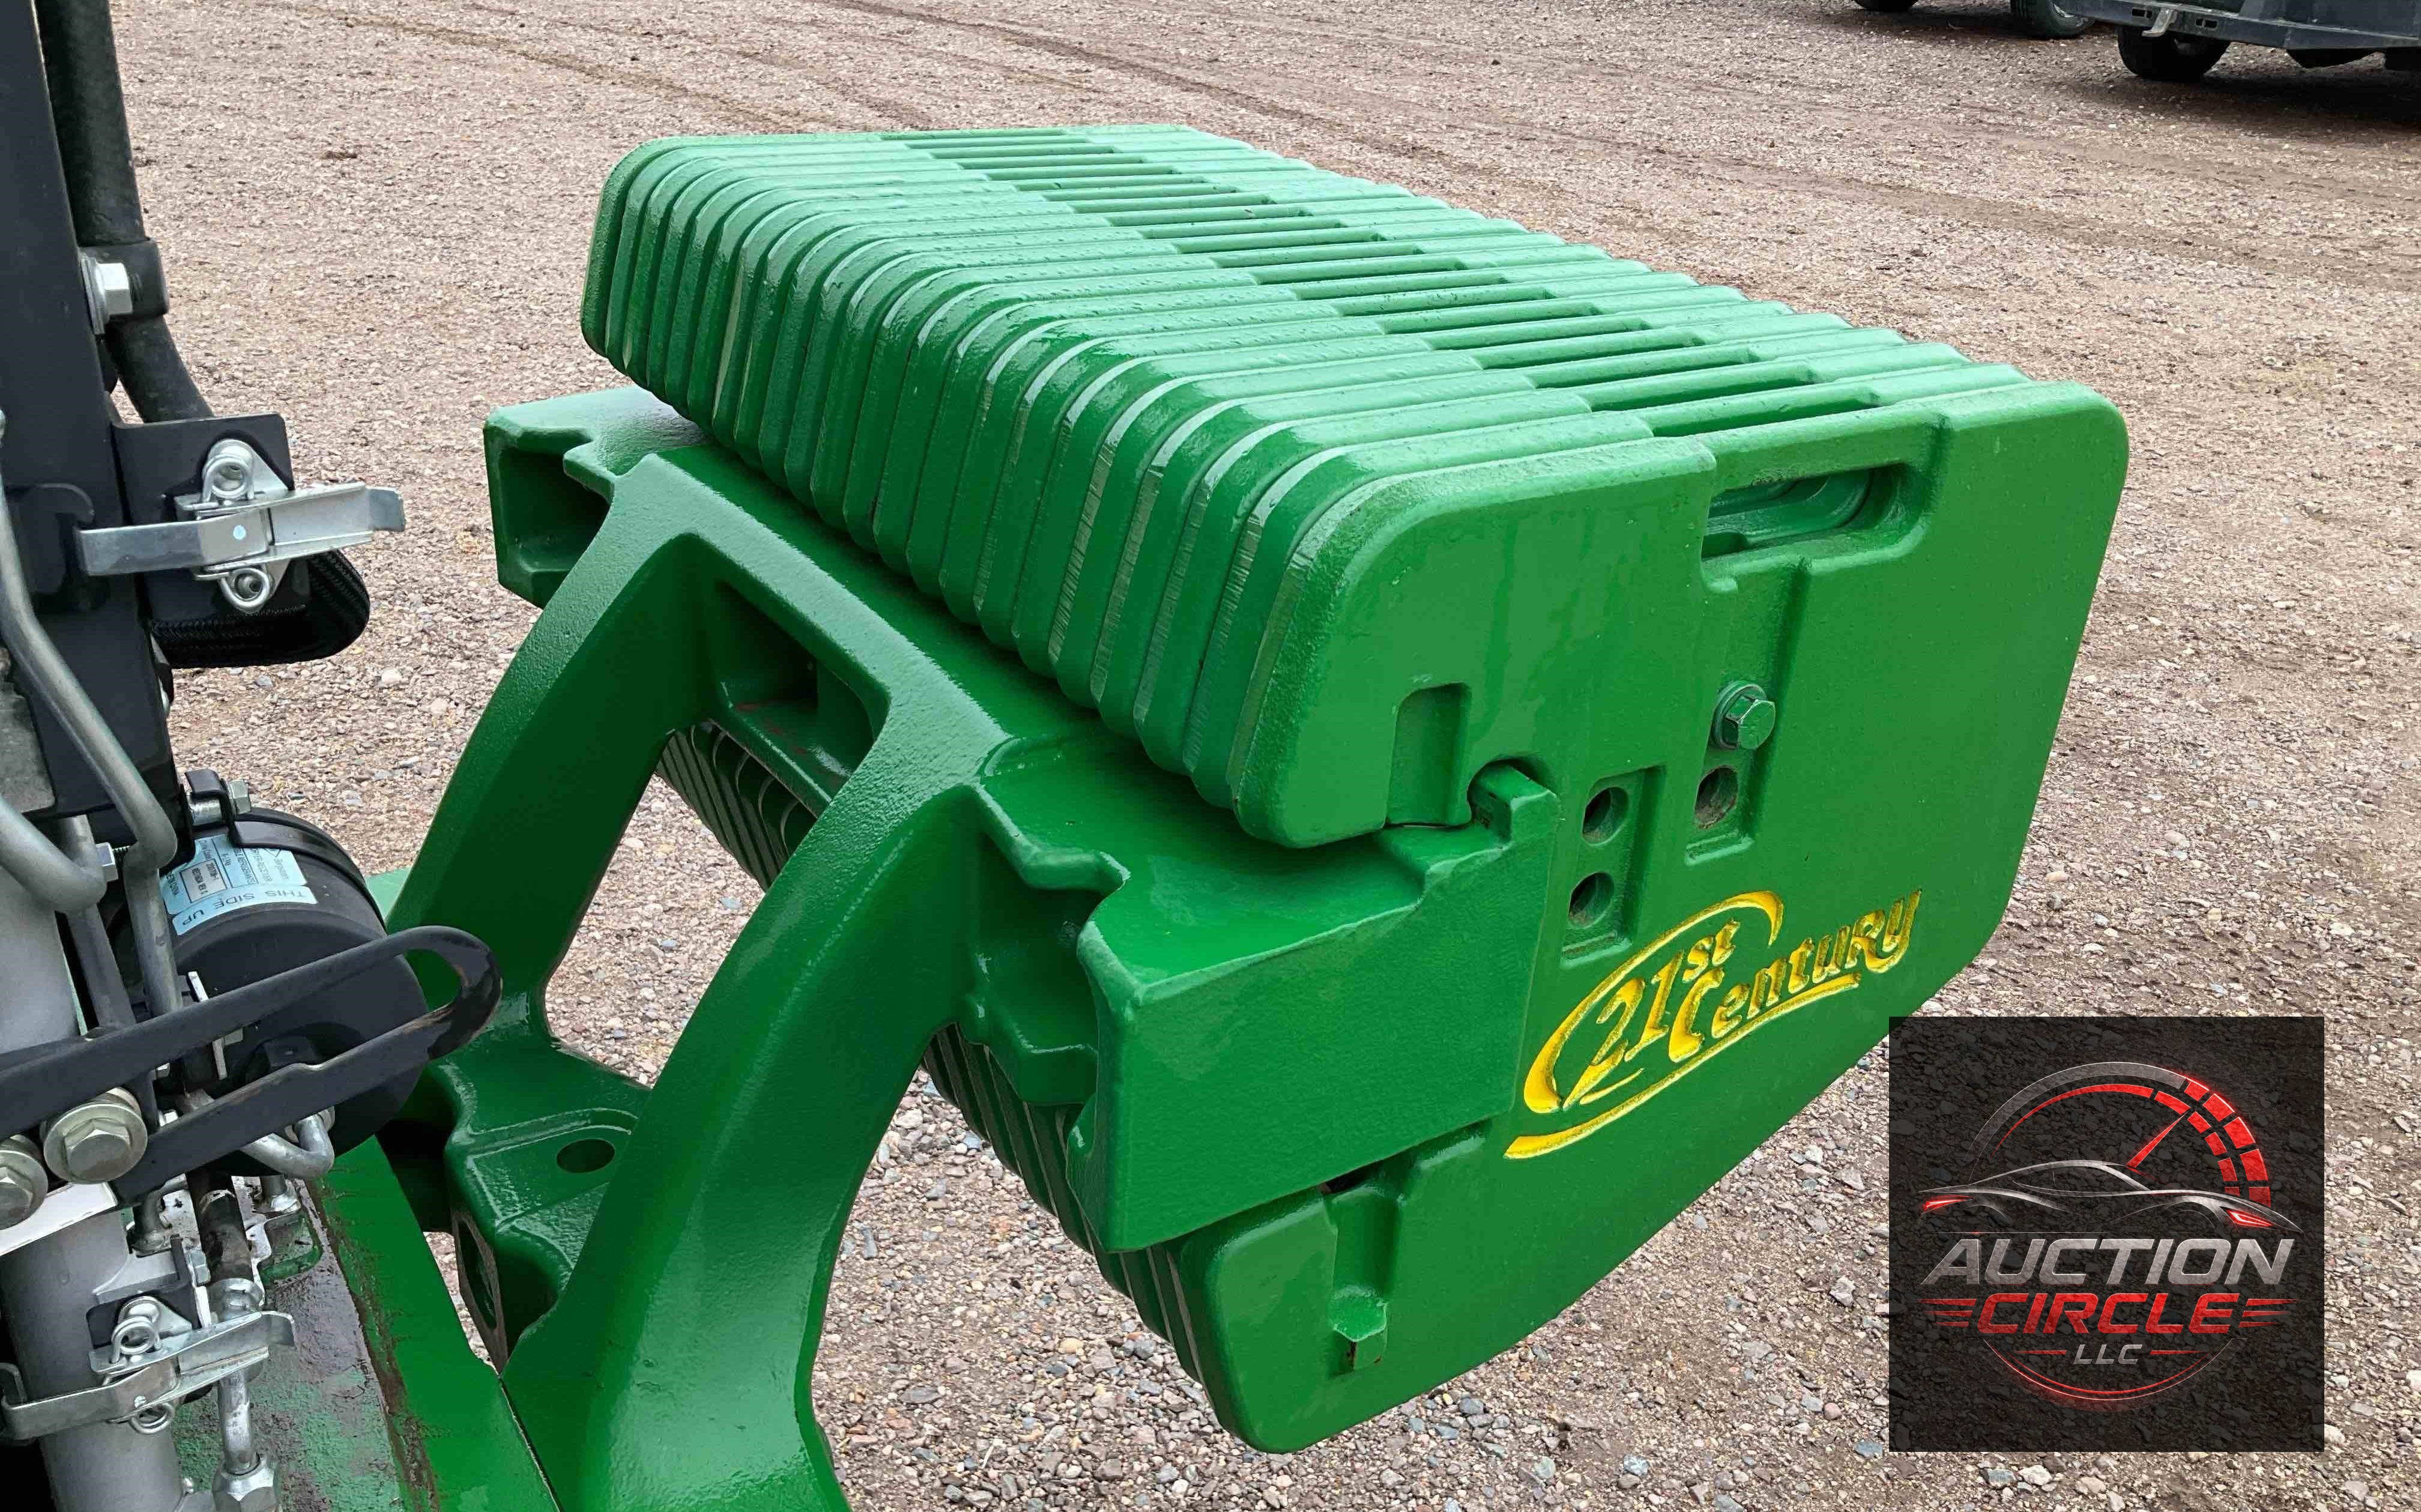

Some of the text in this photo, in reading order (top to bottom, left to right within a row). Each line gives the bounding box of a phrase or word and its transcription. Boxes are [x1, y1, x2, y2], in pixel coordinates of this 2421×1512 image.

[182, 889, 307, 925] THIS SIDE UP
[1563, 918, 1741, 1110] 21st
